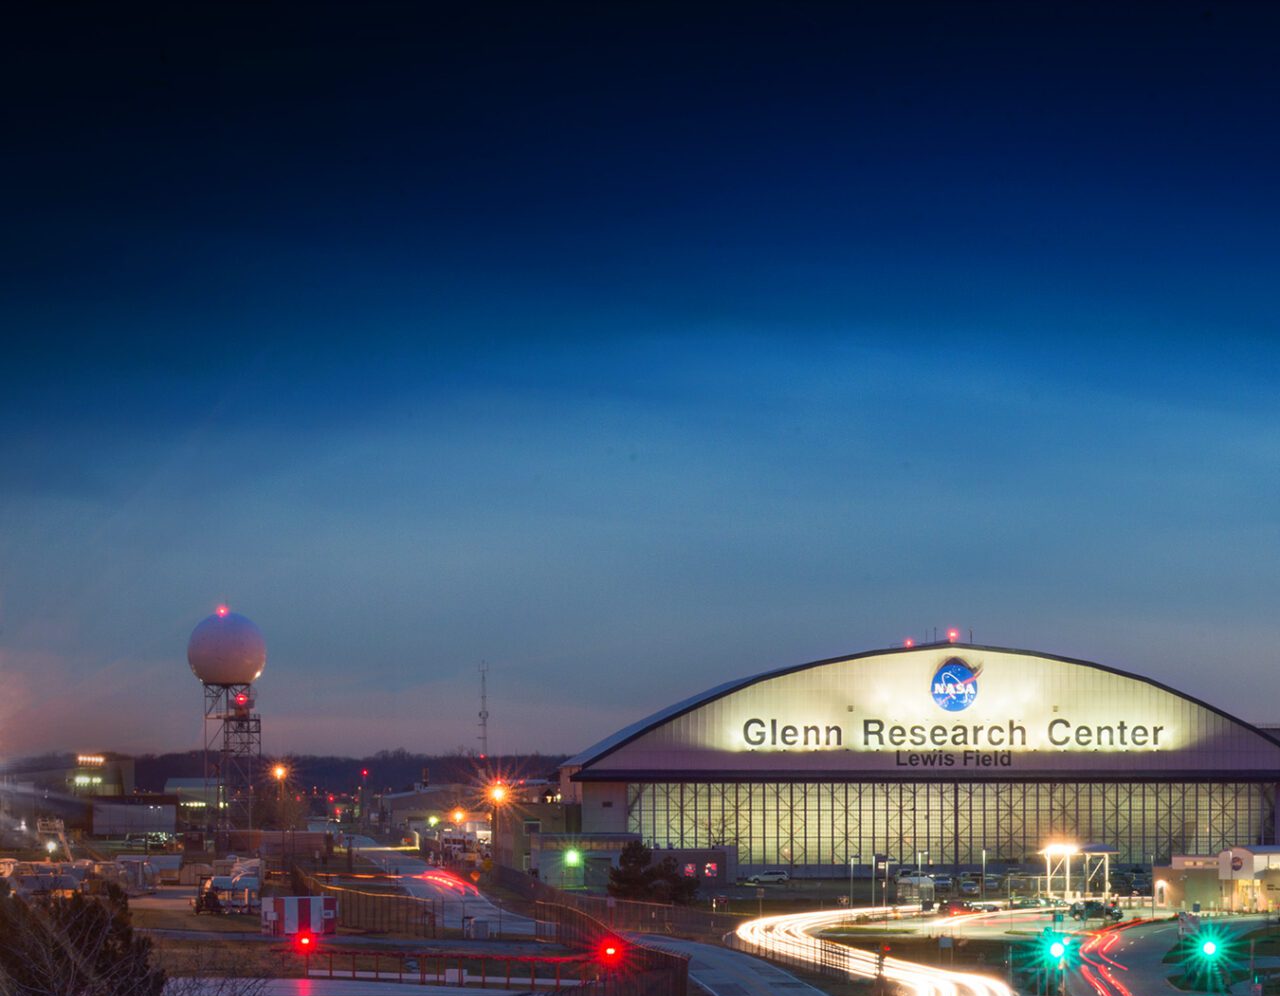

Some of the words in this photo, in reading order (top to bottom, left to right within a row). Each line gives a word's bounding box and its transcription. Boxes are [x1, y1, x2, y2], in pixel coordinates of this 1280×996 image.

[934, 682, 976, 695] NASA
[743, 718, 842, 746] Glenn
[863, 719, 1026, 746] Research
[1048, 718, 1164, 746] Center
[896, 750, 955, 767] Lewis
[963, 750, 1012, 767] Field
